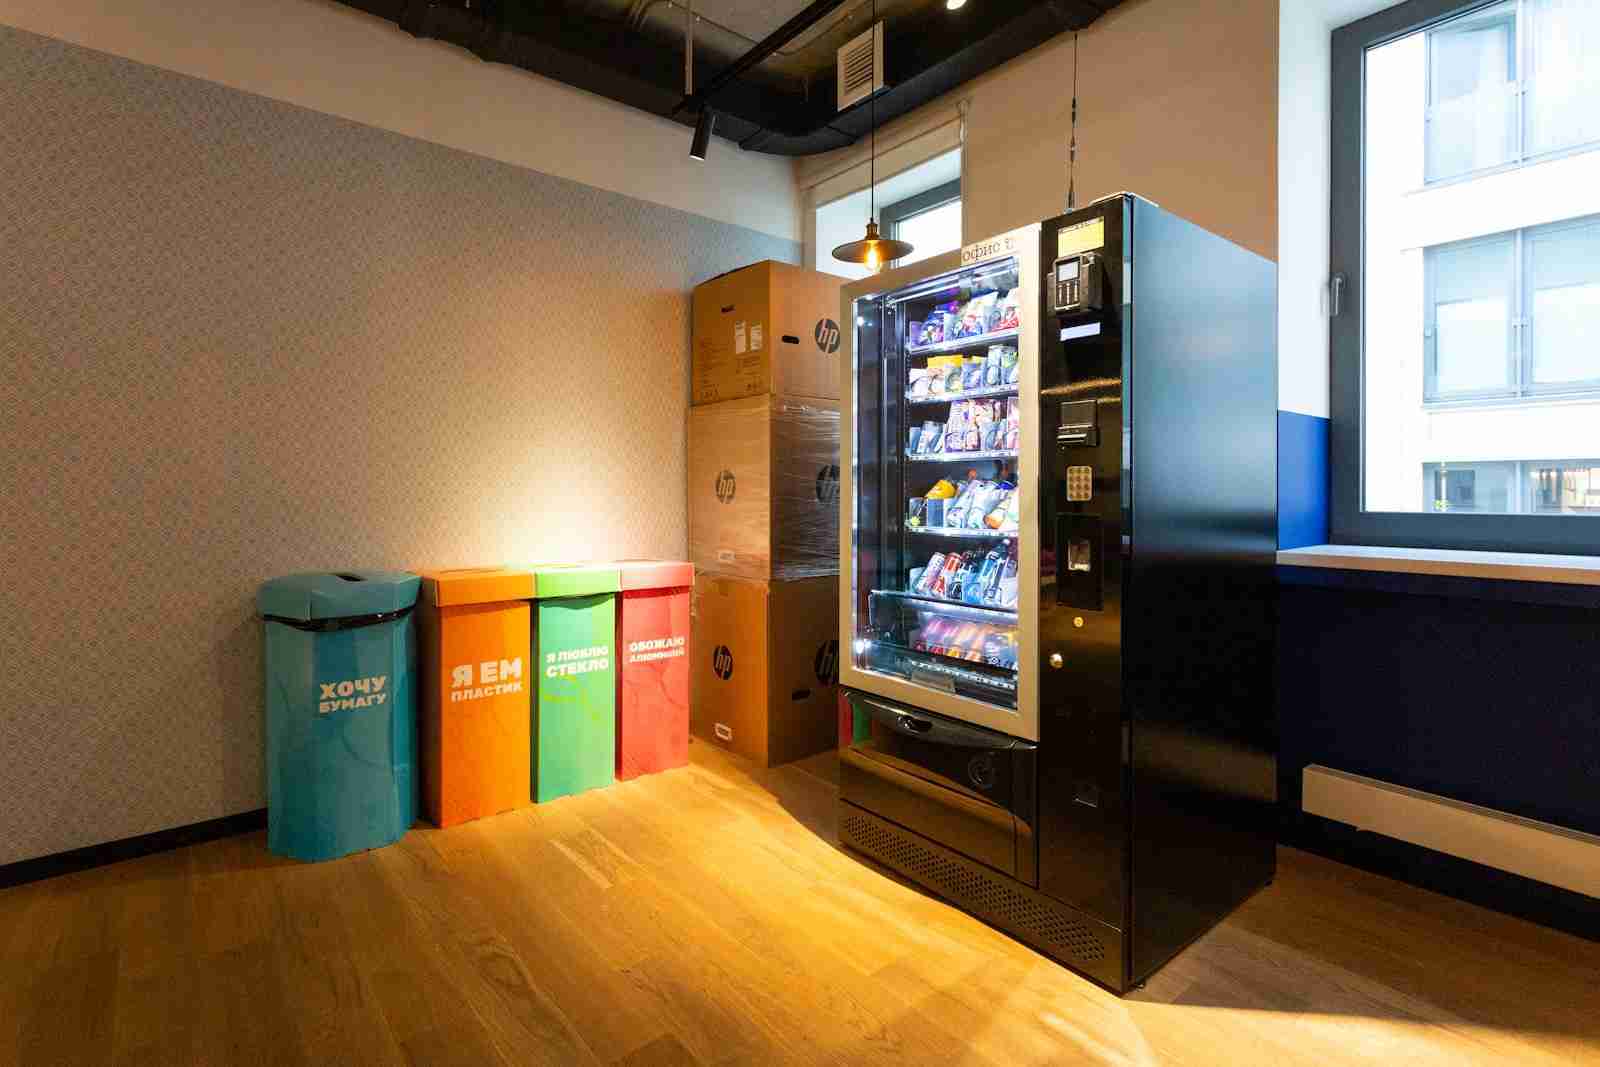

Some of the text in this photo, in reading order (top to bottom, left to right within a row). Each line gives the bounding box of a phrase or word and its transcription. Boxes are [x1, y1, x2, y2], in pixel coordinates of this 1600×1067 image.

[817, 318, 840, 354] hp
[717, 470, 736, 504] hp
[546, 646, 609, 664] Я ЛЮБЛЮ
[630, 637, 685, 652] ОБОЖАЮ
[452, 657, 522, 688] Я ЕМ
[546, 658, 609, 678] СТЕКЛО
[715, 645, 733, 680] hp
[319, 675, 386, 700] ХОЧУ
[451, 681, 523, 703] ПЛАСТИК
[319, 693, 386, 714] БУМАГУ
